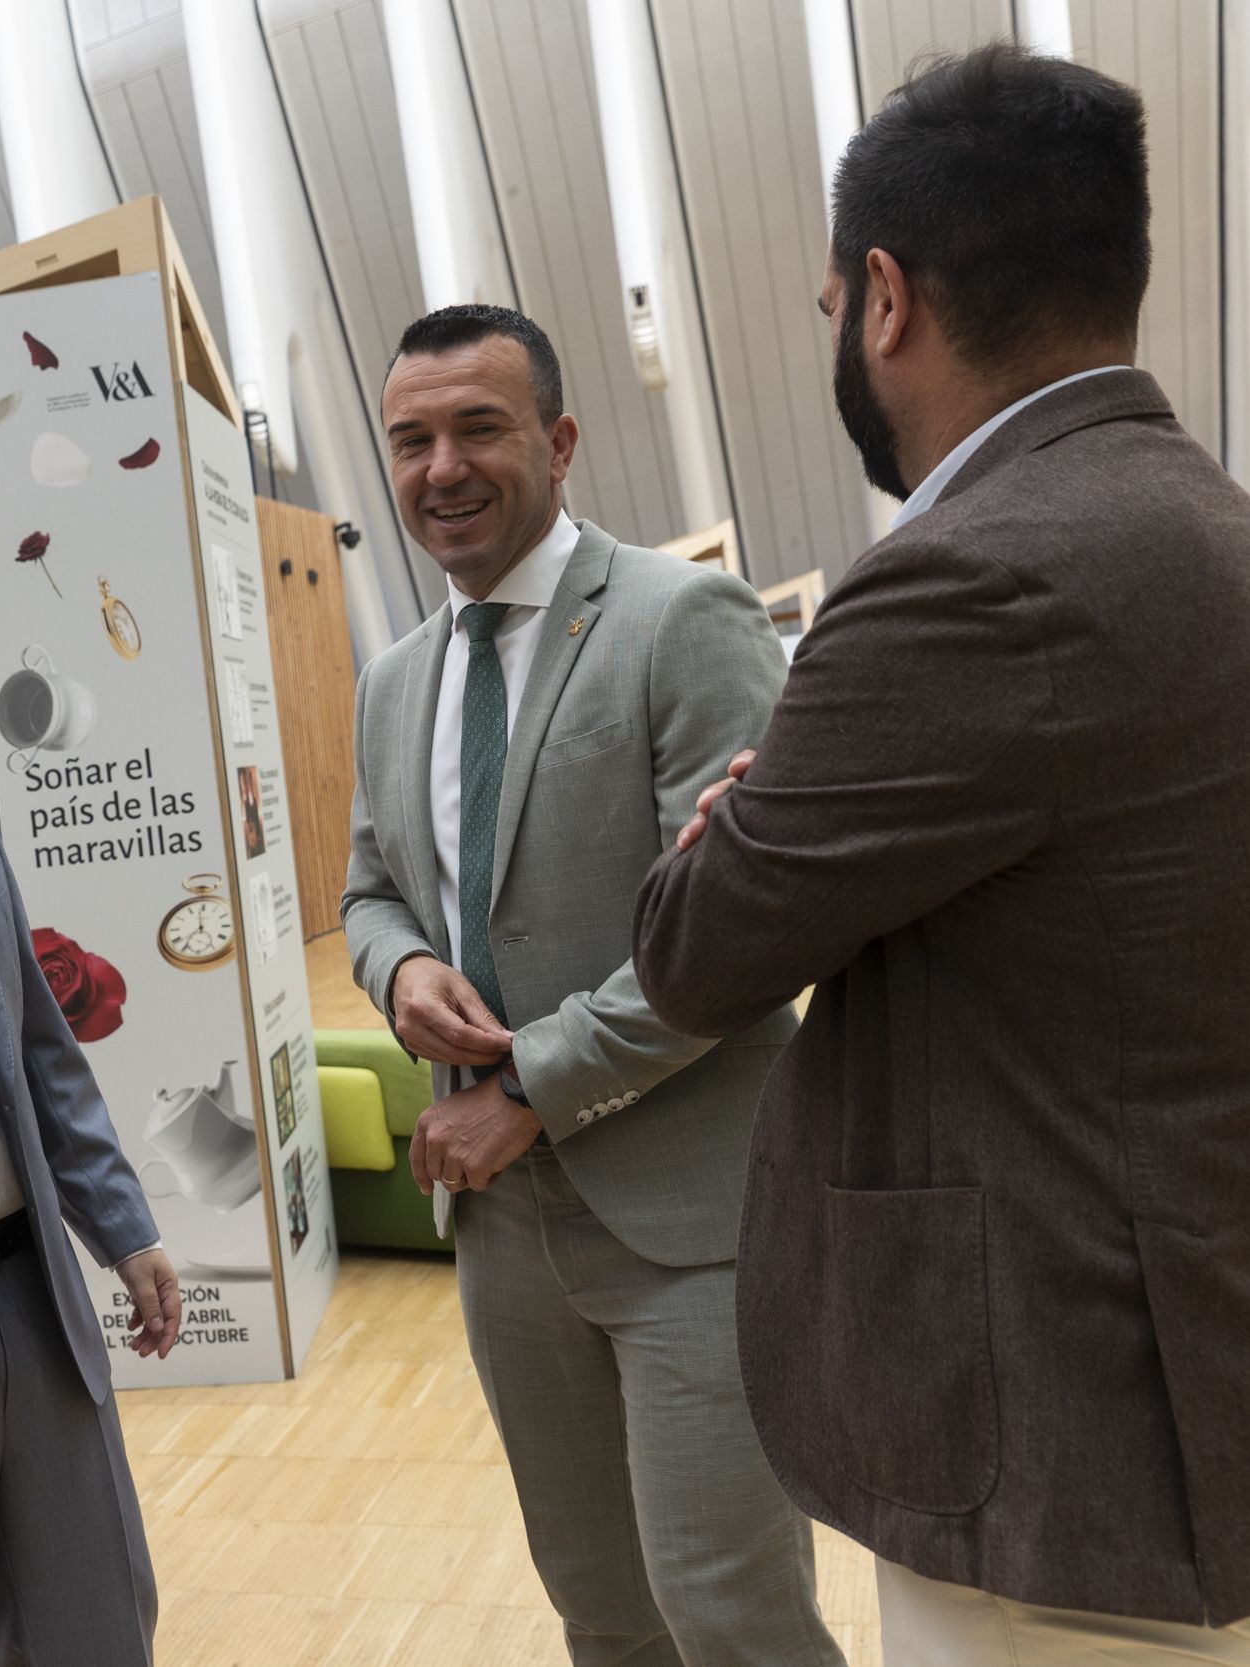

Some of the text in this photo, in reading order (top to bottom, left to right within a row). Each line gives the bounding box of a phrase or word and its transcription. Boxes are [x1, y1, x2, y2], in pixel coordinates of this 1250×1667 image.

[89, 360, 155, 403] V&A
[25, 748, 152, 792] Soñar el
[30, 786, 196, 838] país de las
[34, 825, 203, 868] maravillas
[187, 1309, 236, 1325] ABRIL
